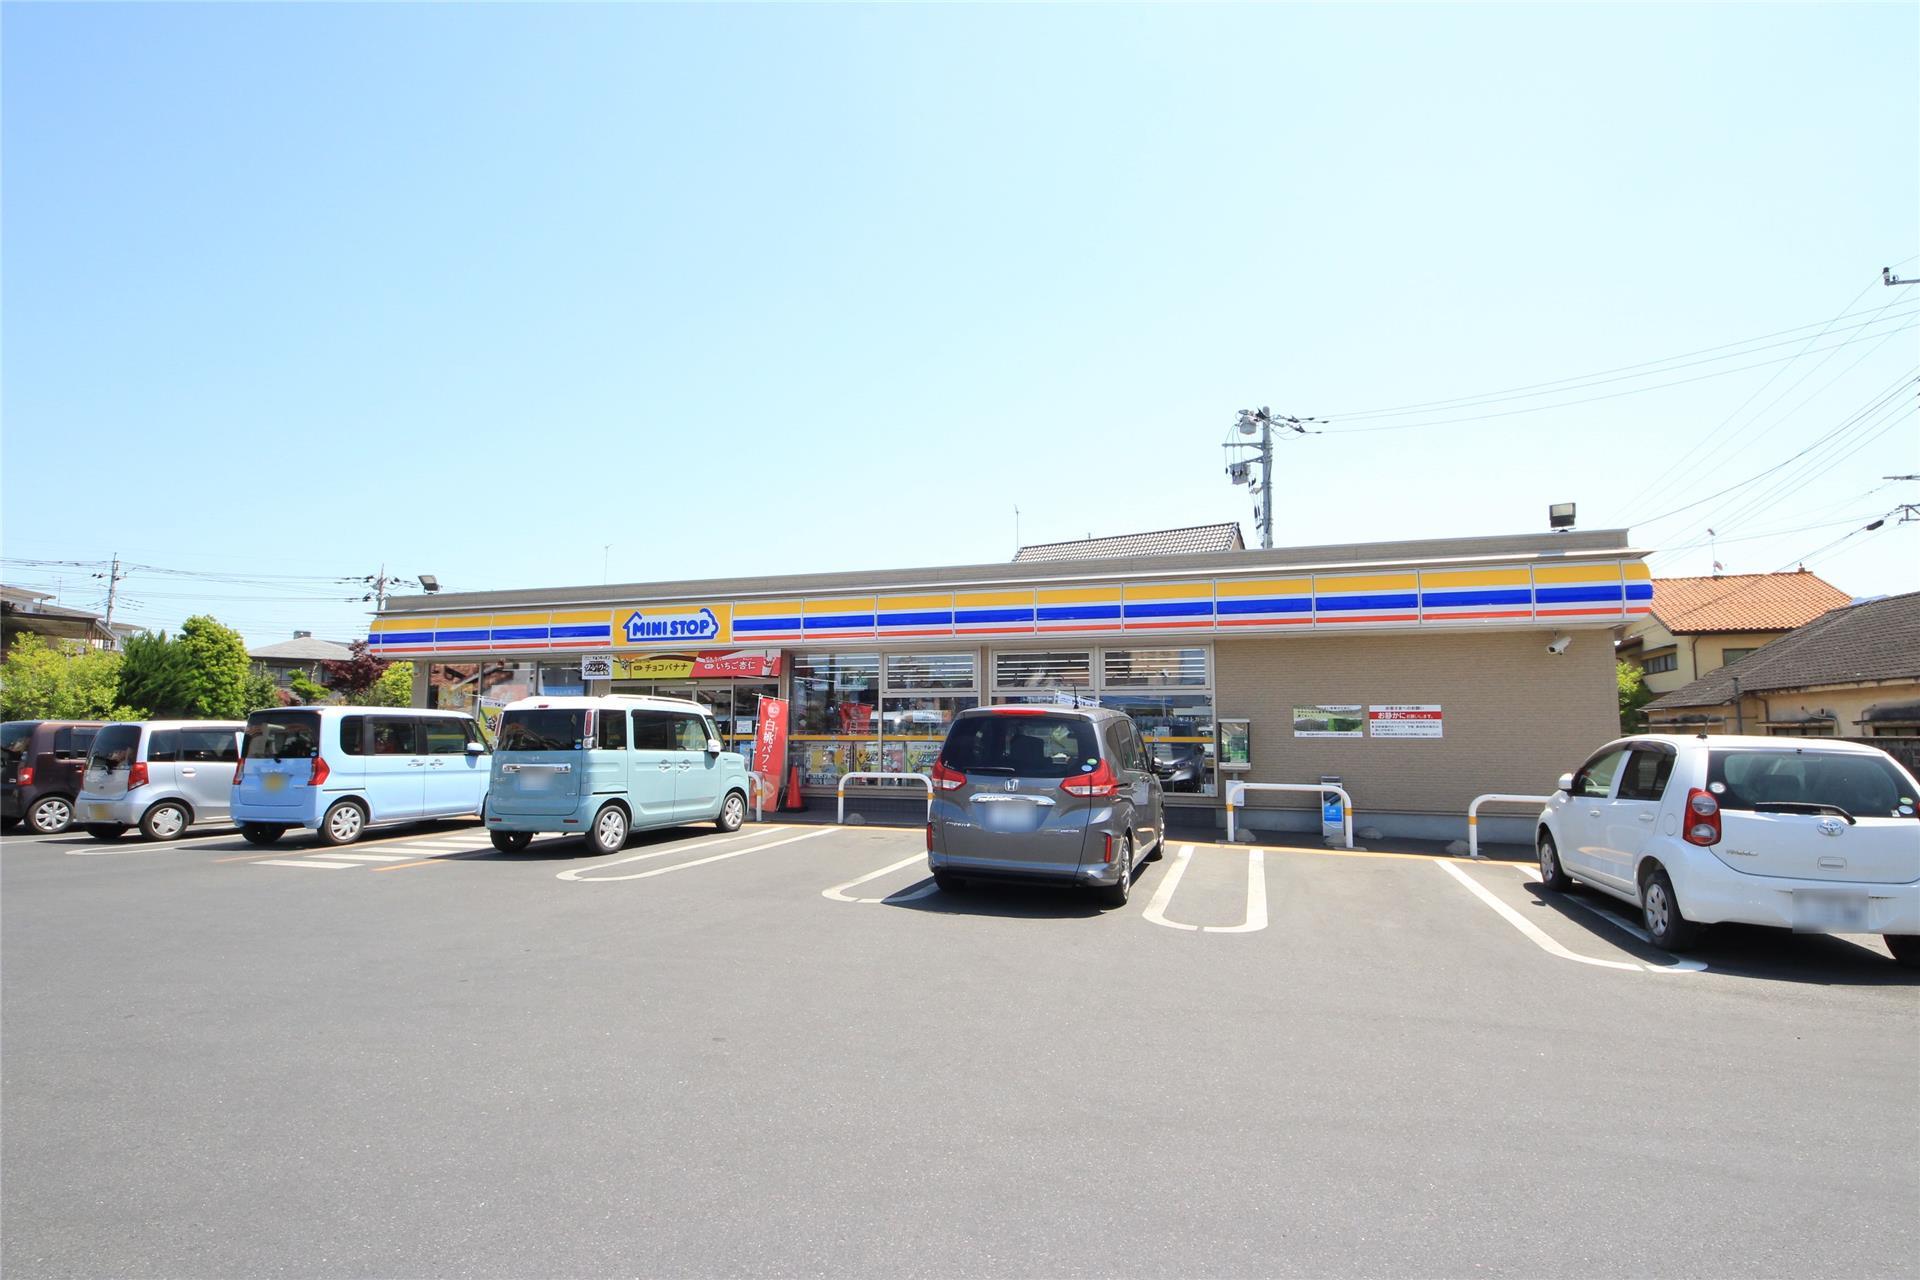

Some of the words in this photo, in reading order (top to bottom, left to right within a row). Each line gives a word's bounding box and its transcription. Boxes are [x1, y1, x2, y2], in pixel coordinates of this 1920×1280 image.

[632, 621, 667, 636] MINI
[670, 619, 710, 635] STOP
[645, 663, 688, 672] チョコバナナ
[715, 660, 757, 670] いちご杏仁
